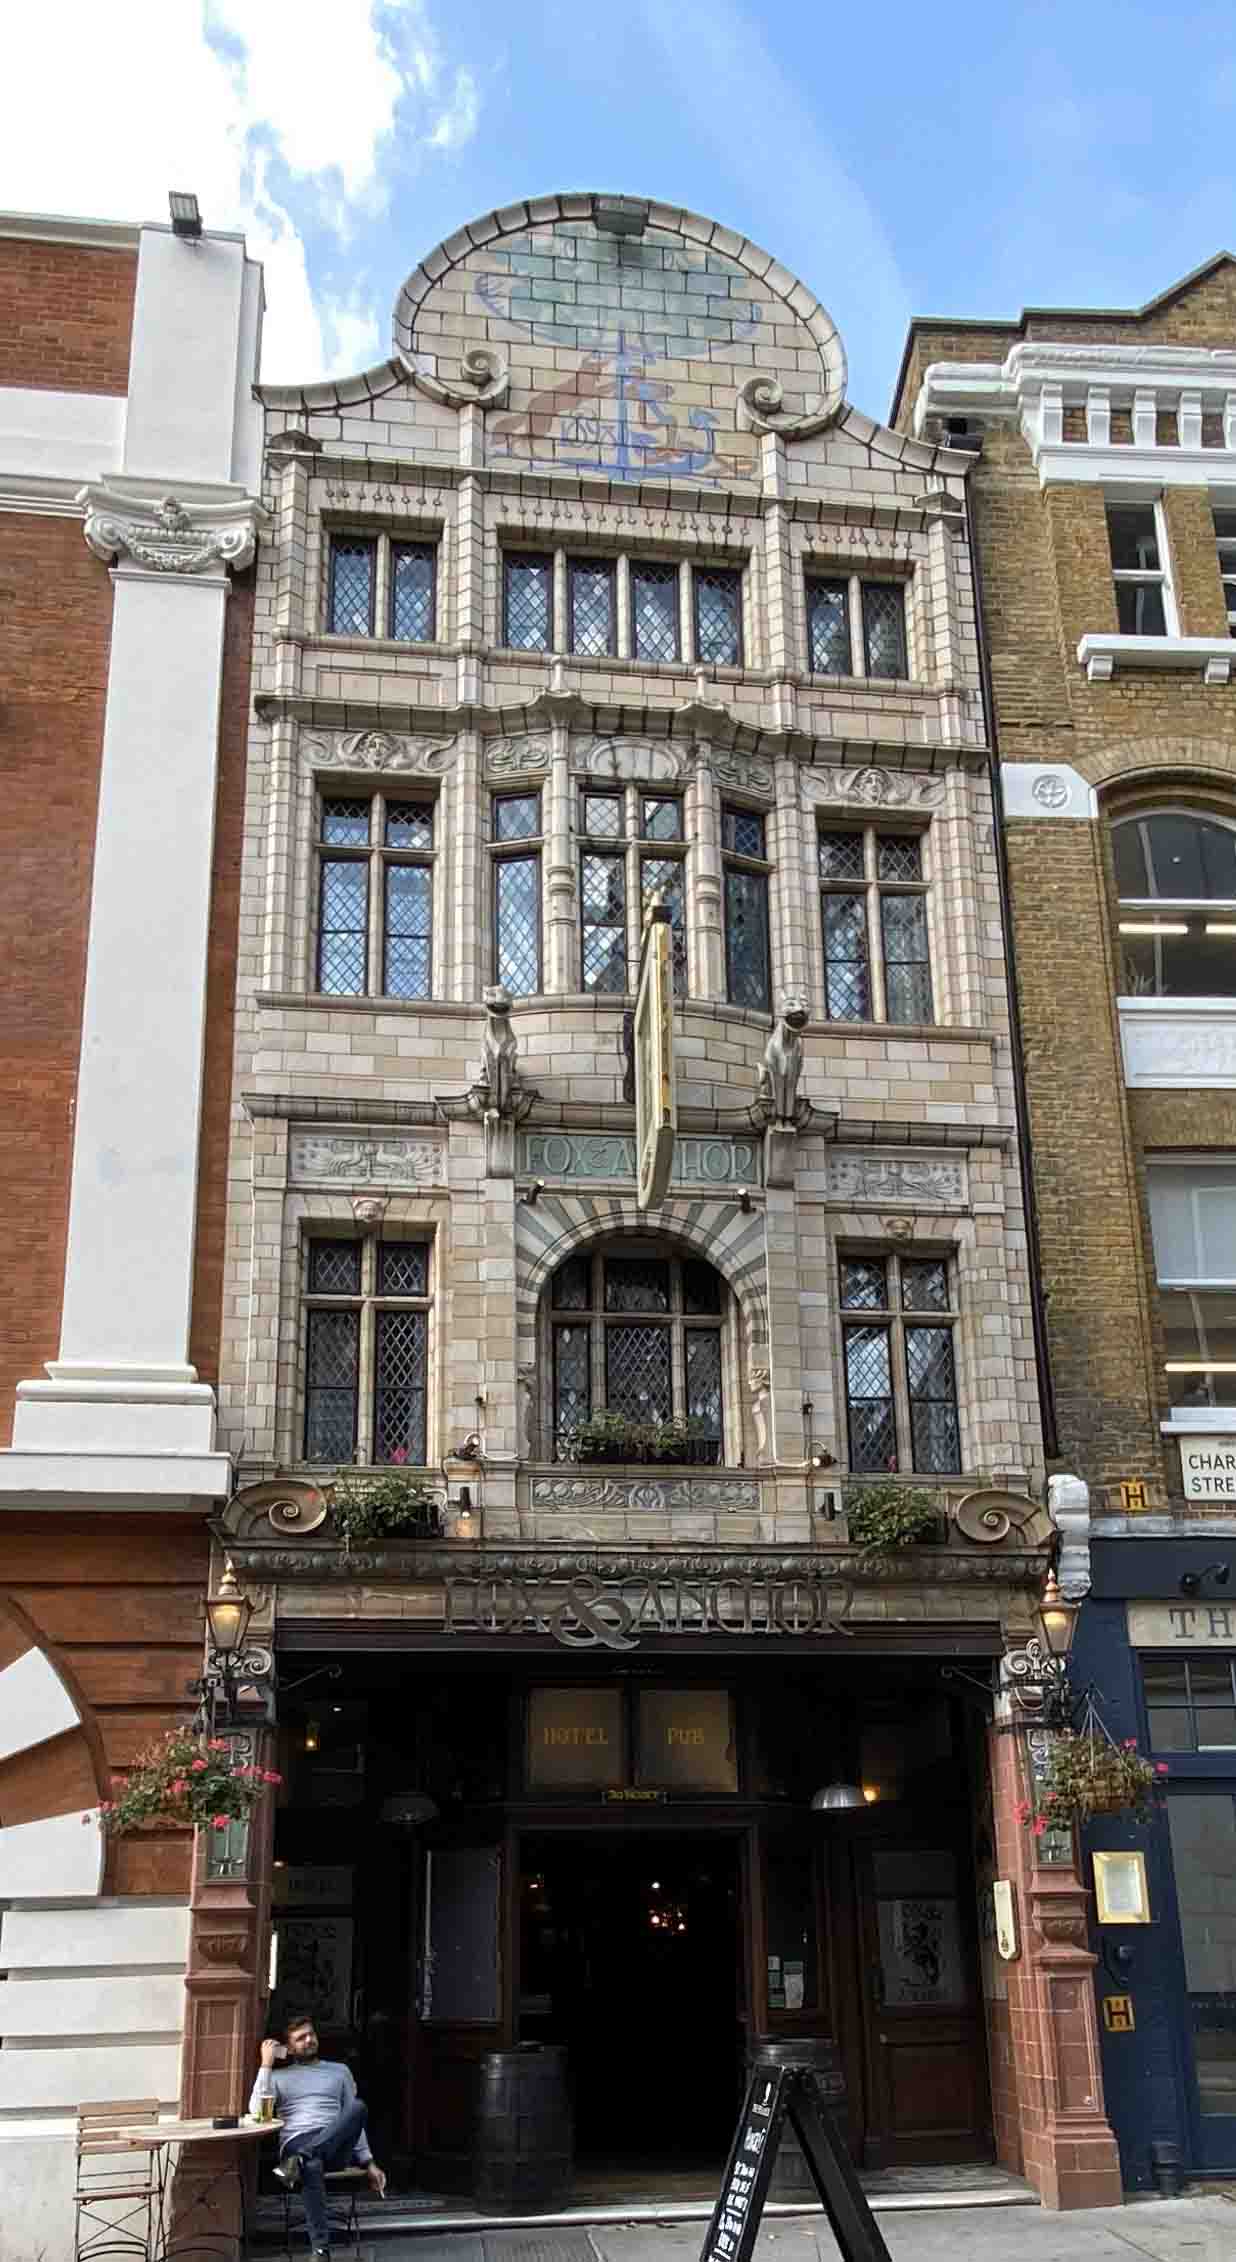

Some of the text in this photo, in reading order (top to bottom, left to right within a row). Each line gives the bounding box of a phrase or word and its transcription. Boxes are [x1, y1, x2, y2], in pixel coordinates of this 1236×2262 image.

[526, 1137, 593, 1175] FOX
[602, 1139, 754, 1181] AHOR
[1188, 1453, 1236, 1471] CHAR
[1191, 1476, 1236, 1493] STRE
[1125, 1484, 1146, 1508] H
[443, 1574, 856, 1650] FOX & ANCHOR
[543, 1727, 609, 1745] HOTEL
[666, 1727, 704, 1745] PUB
